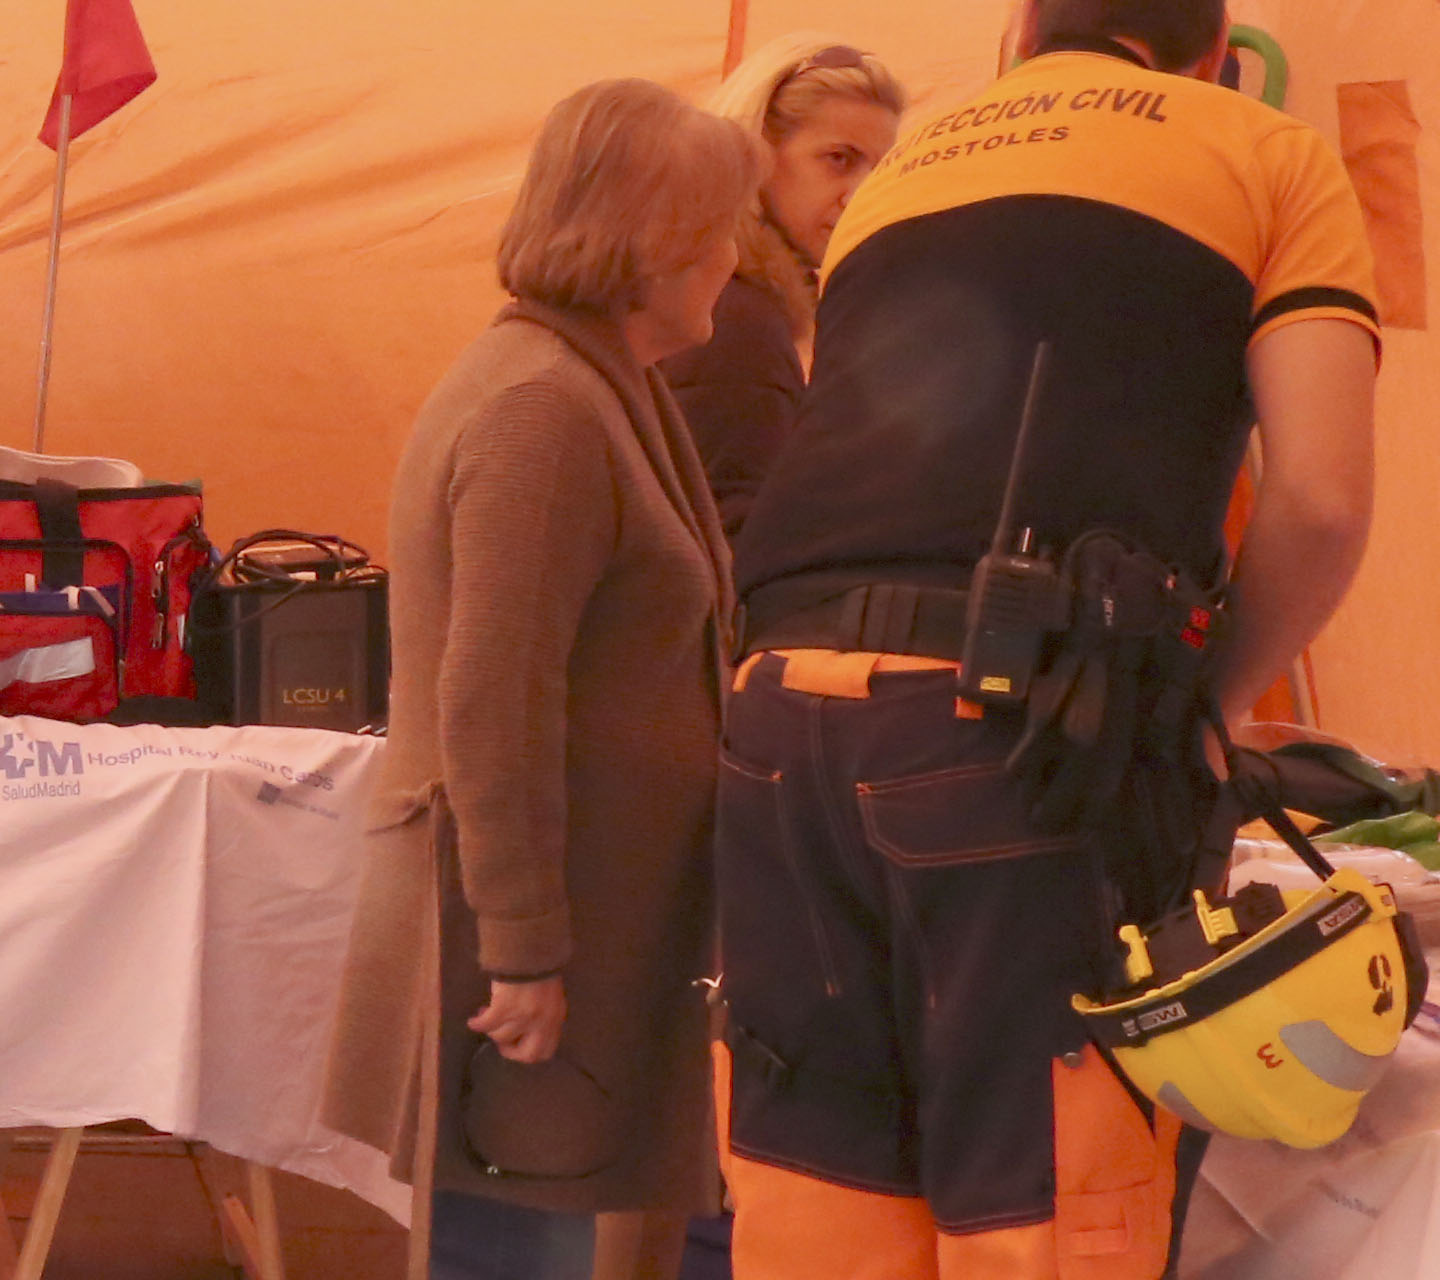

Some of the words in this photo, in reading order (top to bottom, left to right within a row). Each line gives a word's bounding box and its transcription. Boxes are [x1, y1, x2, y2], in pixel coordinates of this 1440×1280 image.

[1069, 88, 1167, 122] CIVIL
[898, 126, 1070, 177] MOSTOLES
[282, 687, 330, 705] LCSU
[87, 743, 172, 767] Hospital
[1, 780, 81, 802] SaludMadrid
